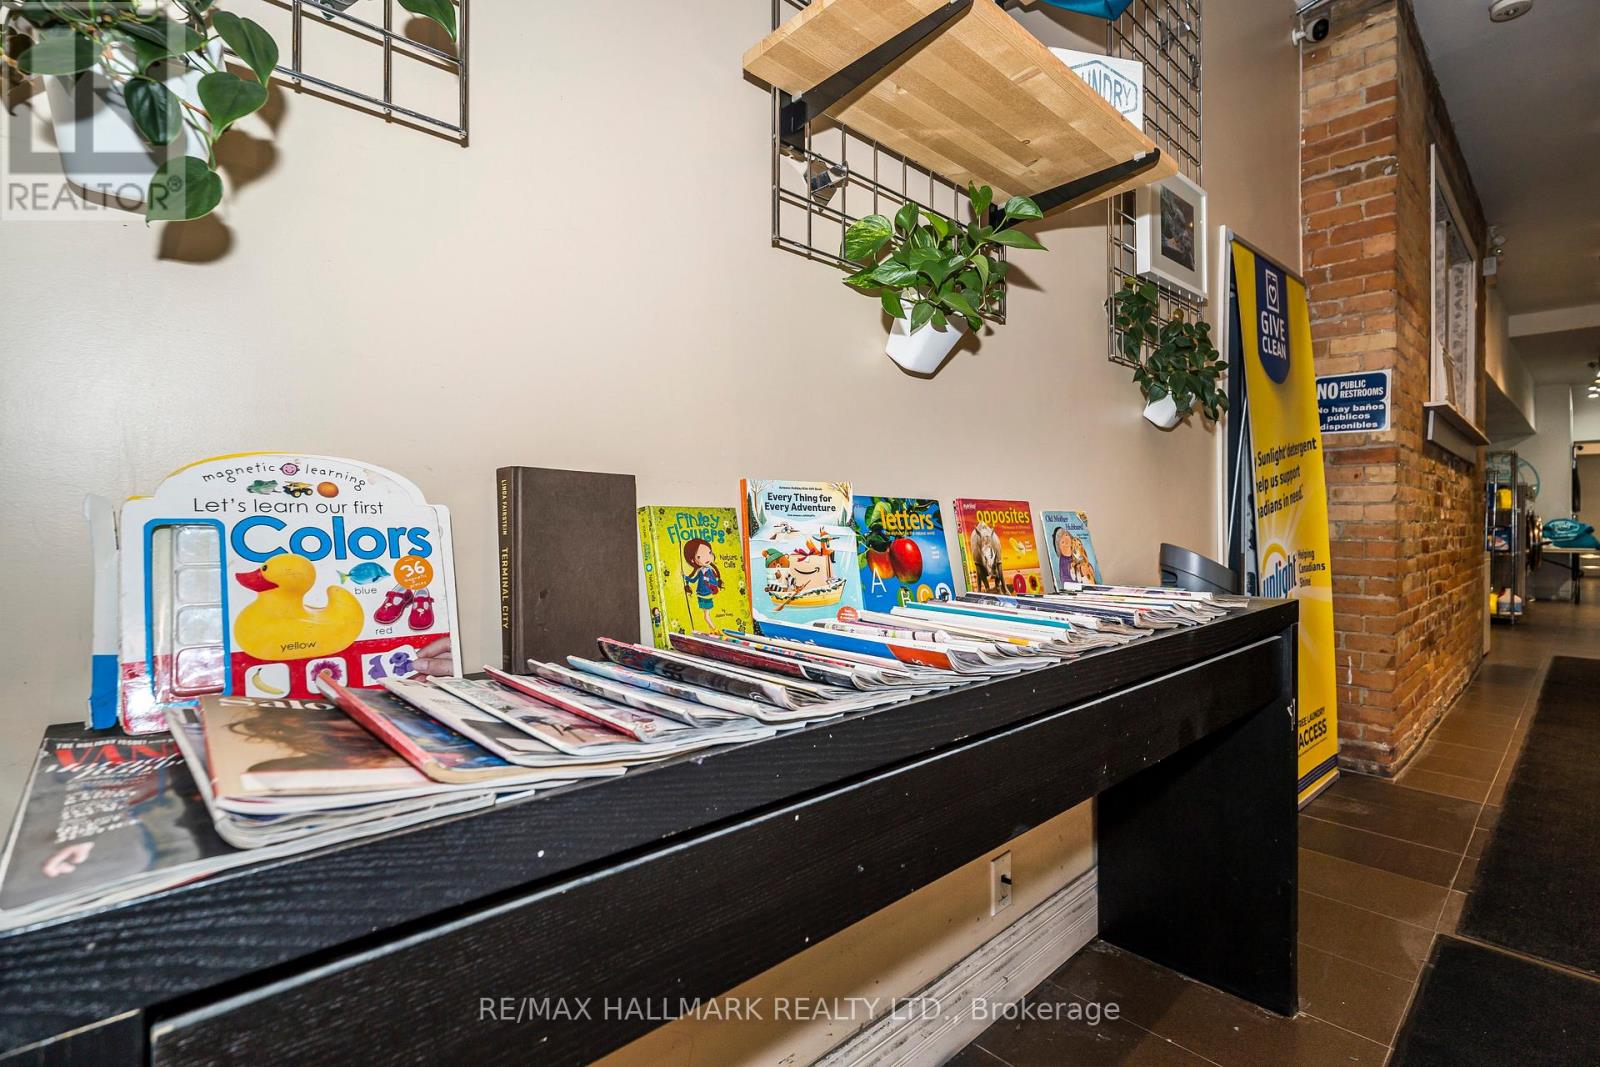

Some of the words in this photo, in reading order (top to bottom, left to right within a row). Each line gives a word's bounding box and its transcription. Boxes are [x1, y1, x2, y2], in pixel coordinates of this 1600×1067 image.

[1261, 311, 1285, 341] GIVE
[1262, 336, 1287, 360] CLEAN
[1316, 382, 1339, 400] NO
[1340, 380, 1366, 390] PUBLIC
[1340, 387, 1384, 399] RESTROOMS
[1327, 413, 1370, 422] públicos
[1331, 406, 1350, 414] hay
[1352, 404, 1385, 412] baños
[1319, 421, 1378, 431] disponibles
[1287, 438, 1317, 457] detergent
[202, 462, 276, 483] magnetic
[305, 464, 366, 491] learning
[1270, 475, 1279, 488] us
[1280, 464, 1300, 486] support
[193, 498, 247, 513] Let's
[254, 498, 308, 513] learn
[315, 503, 347, 514] our
[353, 500, 384, 515] first
[767, 492, 793, 503] Every
[793, 493, 818, 504] Thing
[819, 494, 833, 502] for
[1283, 493, 1289, 508] in
[764, 502, 790, 513] Every
[790, 502, 837, 512] Adventure
[676, 512, 721, 529] Finley
[880, 508, 934, 530] letters
[976, 507, 1031, 527] opposites
[1045, 514, 1053, 522] Old
[231, 515, 433, 562] Colors
[667, 523, 726, 545] Flowers
[400, 560, 426, 578] 36
[501, 547, 509, 602] TERMINAL
[1299, 562, 1326, 573] Canadians
[871, 568, 887, 594] A
[1262, 555, 1297, 600] unlight
[354, 586, 377, 595] blue
[375, 627, 393, 635] red
[280, 640, 316, 653] yellow
[1298, 718, 1327, 750] ACCESS
